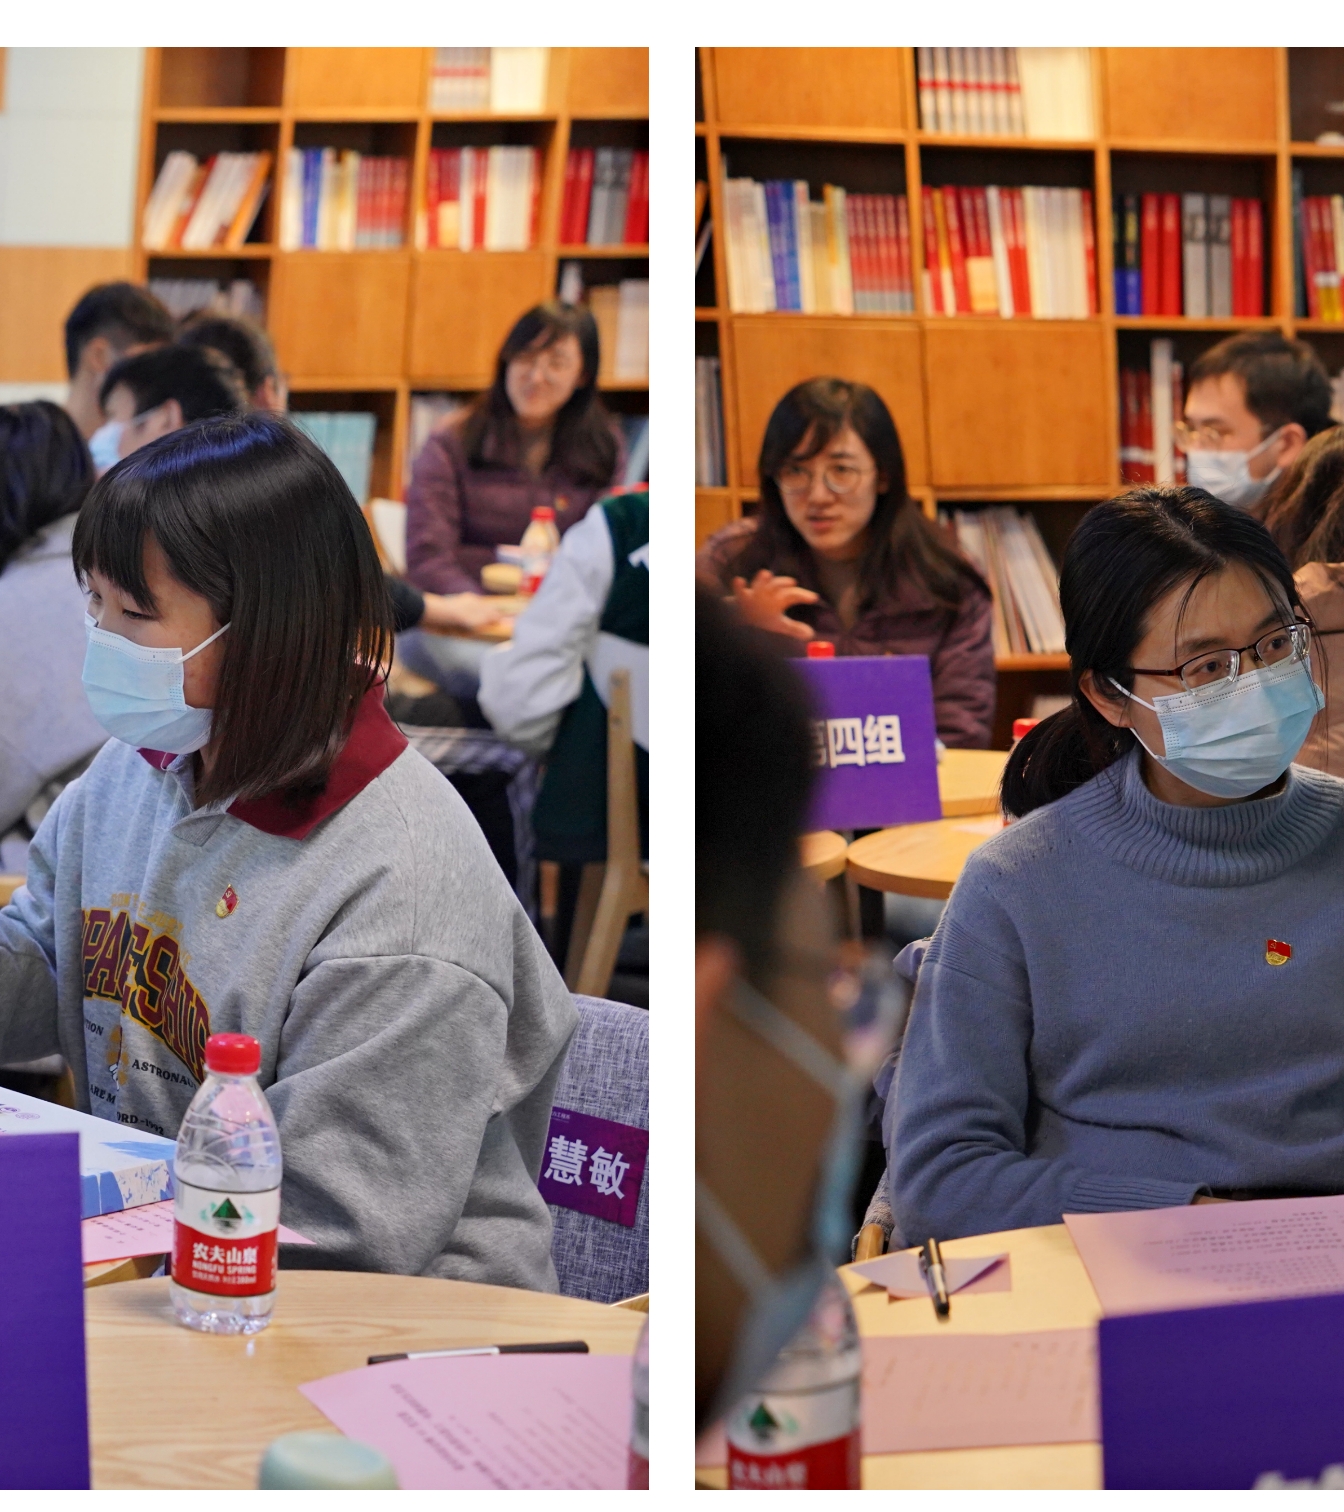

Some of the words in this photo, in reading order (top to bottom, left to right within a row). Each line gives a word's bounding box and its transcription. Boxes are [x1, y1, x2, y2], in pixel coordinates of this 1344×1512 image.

[544, 1134, 631, 1200] 慧敏
[192, 1242, 259, 1265] 农夫山泉
